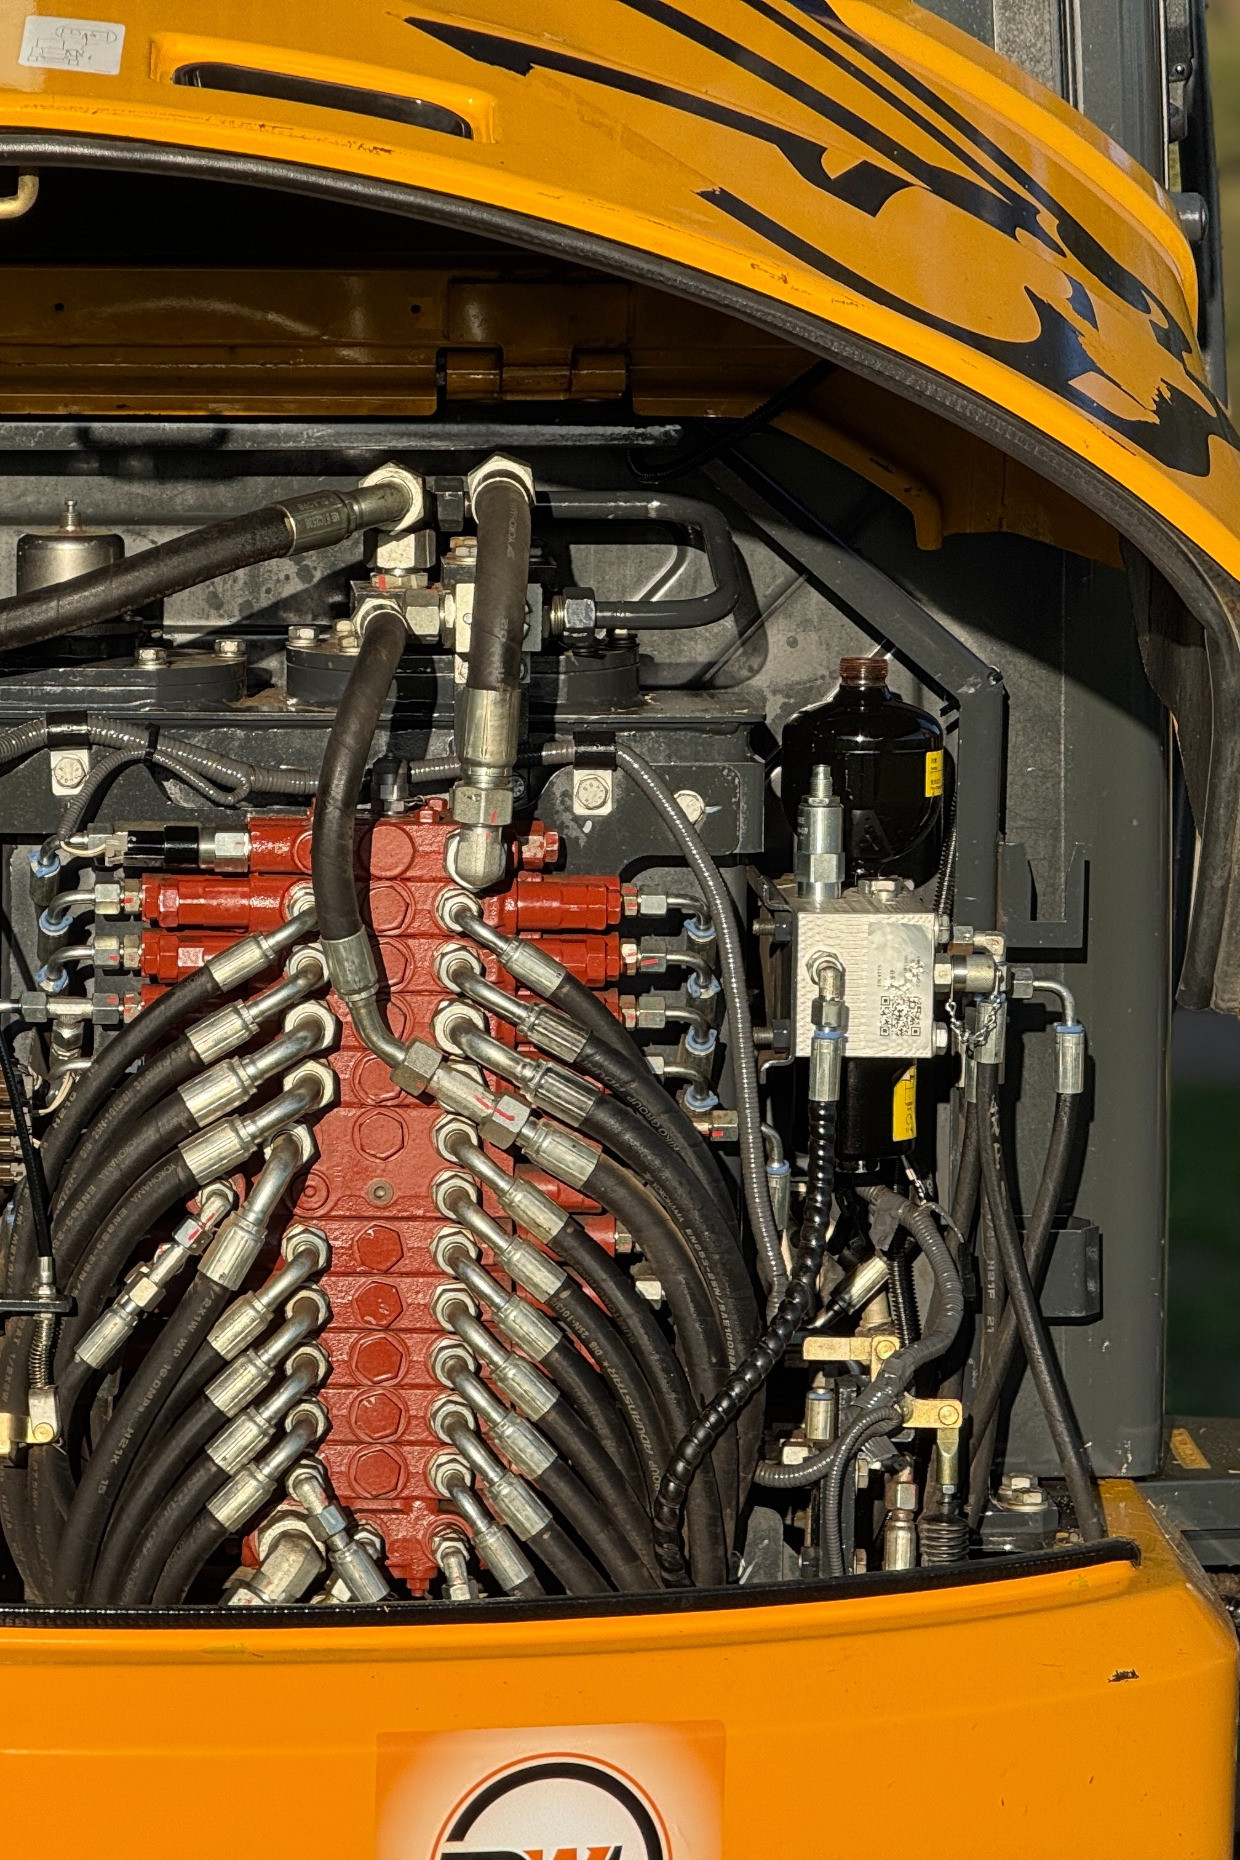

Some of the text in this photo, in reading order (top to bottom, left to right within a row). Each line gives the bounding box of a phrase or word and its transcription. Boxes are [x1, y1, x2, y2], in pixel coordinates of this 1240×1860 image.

[626, 1094, 661, 1128] GROUP
[130, 1162, 178, 1203] YOKOHAMA
[651, 1181, 685, 1223] YOKOHAMA
[986, 1259, 996, 1334] H21F 21
[172, 1338, 188, 1358] WP
[109, 1427, 135, 1465] H21K
